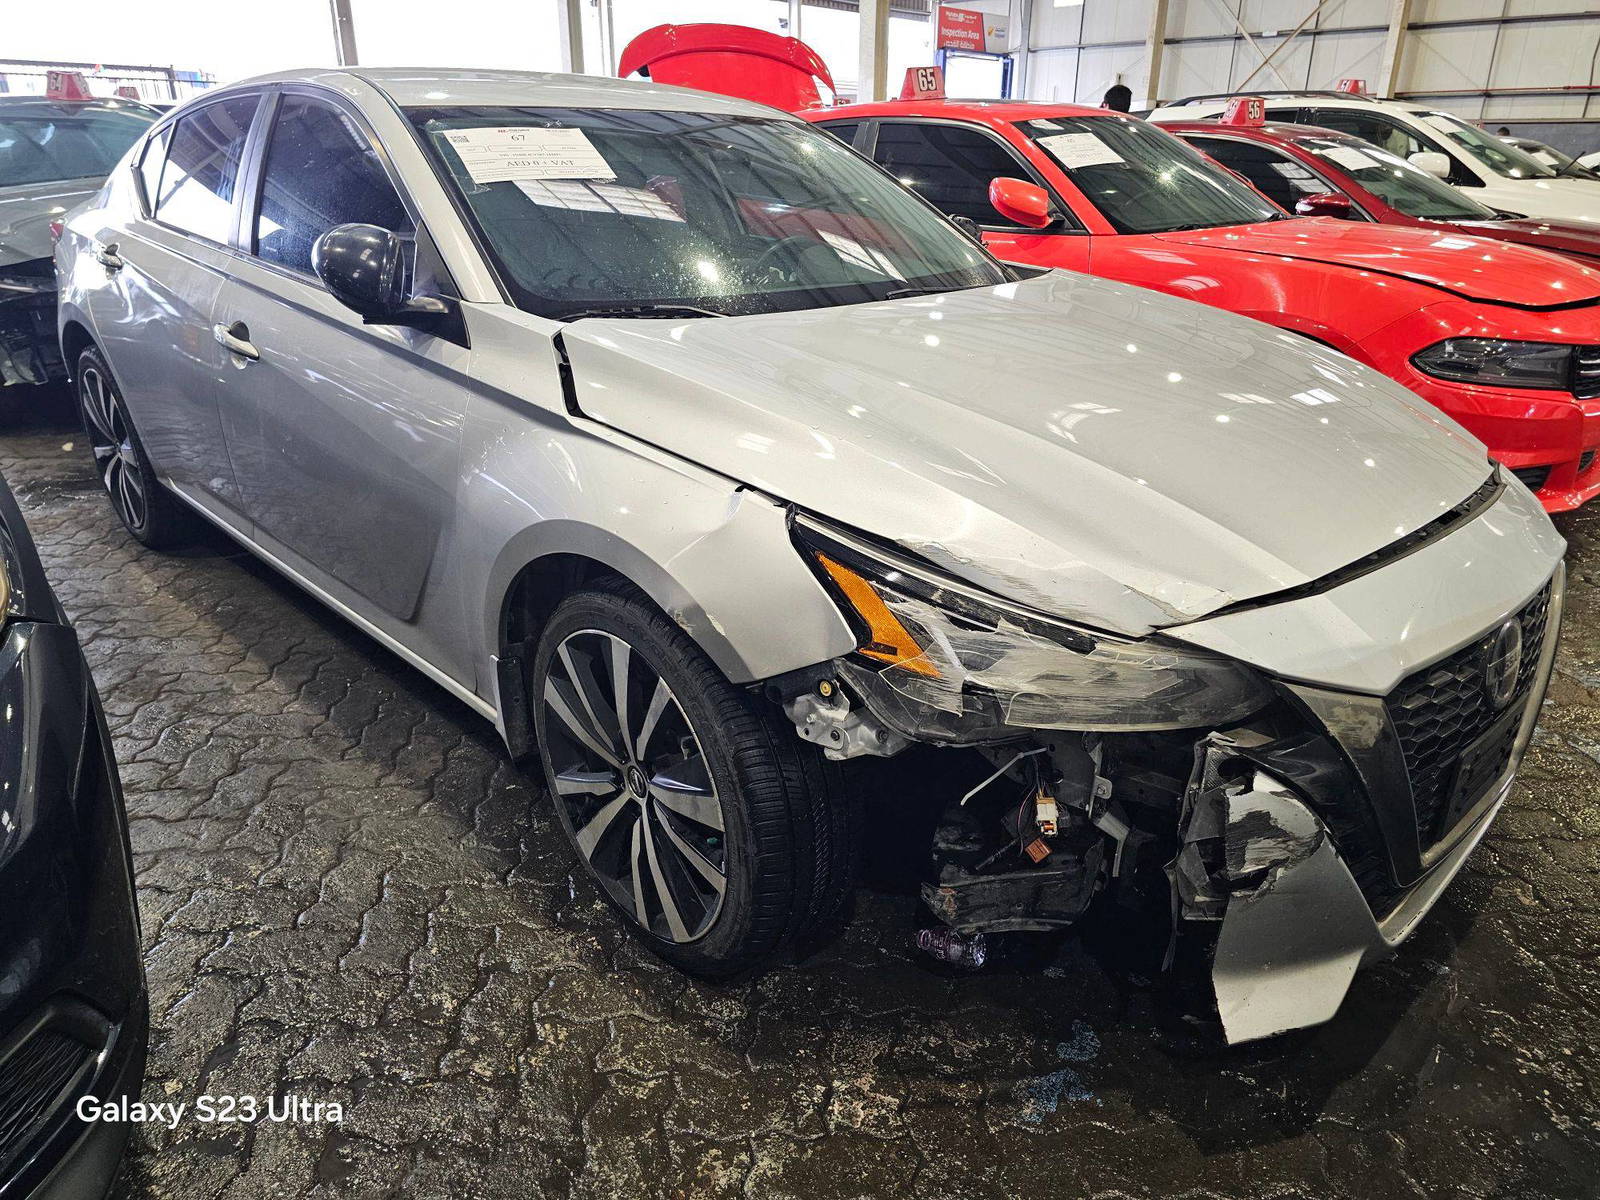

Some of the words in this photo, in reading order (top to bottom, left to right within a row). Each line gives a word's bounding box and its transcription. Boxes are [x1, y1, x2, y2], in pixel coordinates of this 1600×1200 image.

[942, 28, 968, 38] Inspection
[968, 30, 980, 40] Area
[50, 73, 63, 91] 64
[917, 68, 937, 91] 65
[1248, 101, 1260, 119] 56
[511, 134, 525, 142] 67
